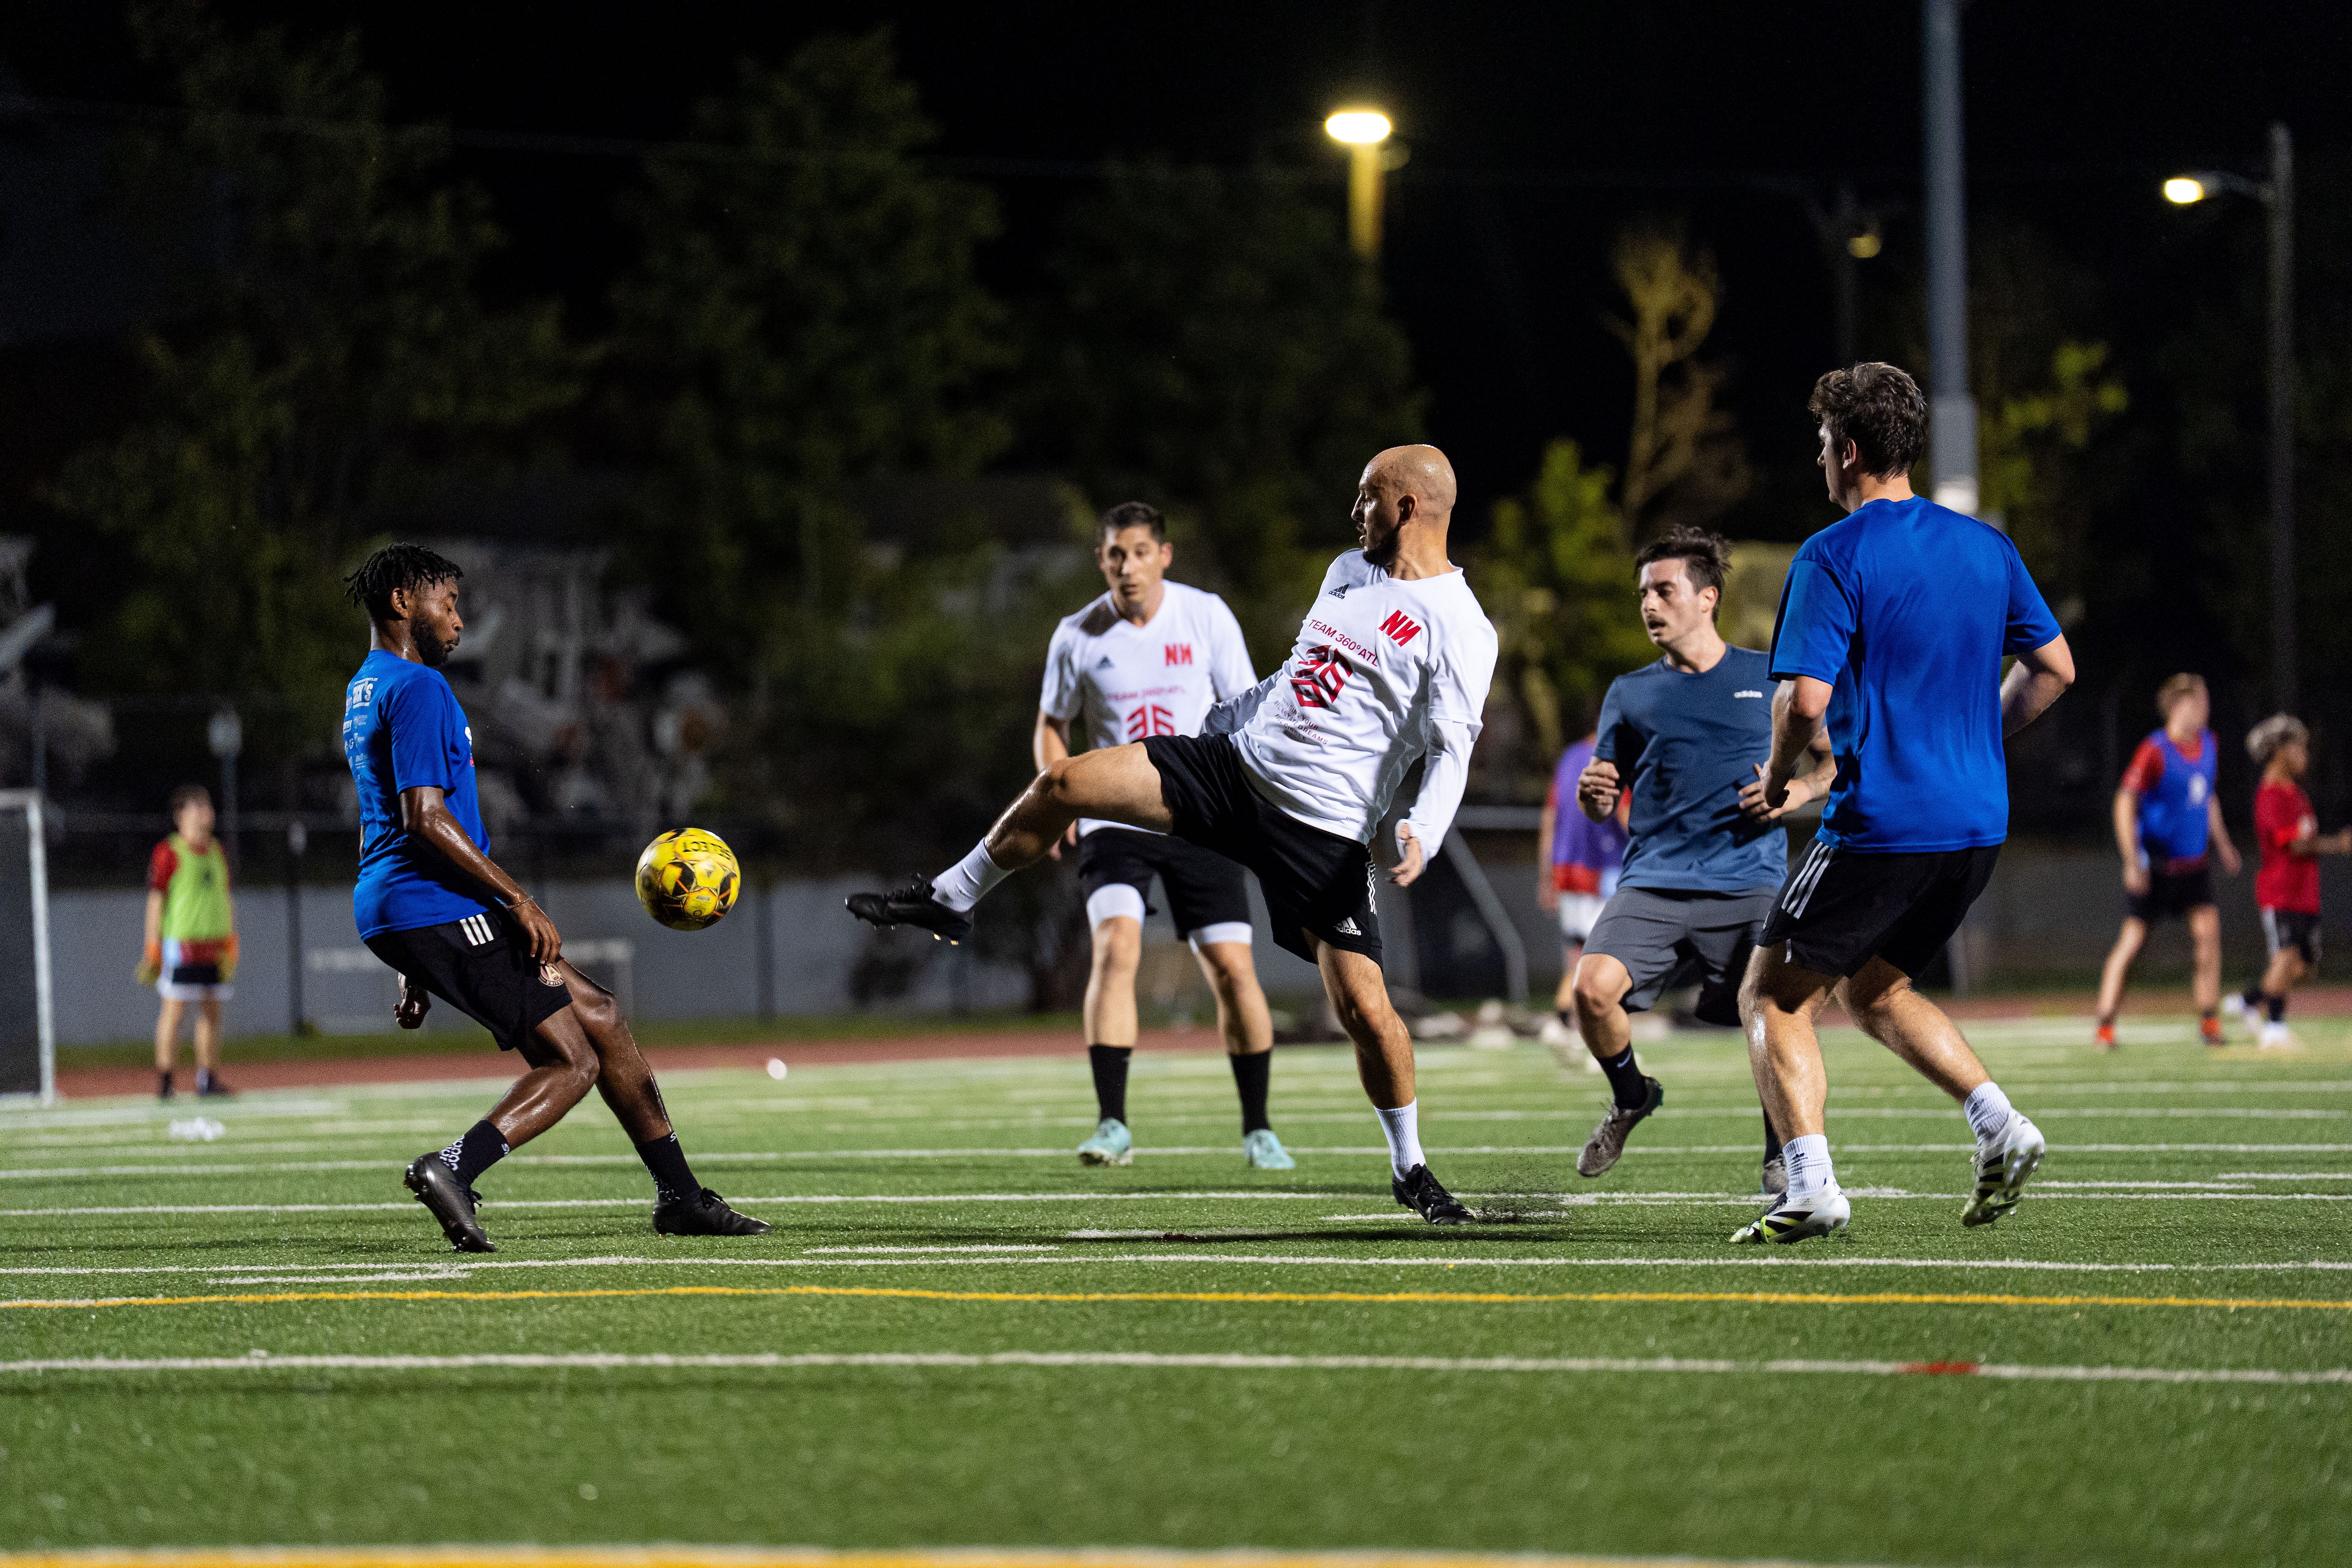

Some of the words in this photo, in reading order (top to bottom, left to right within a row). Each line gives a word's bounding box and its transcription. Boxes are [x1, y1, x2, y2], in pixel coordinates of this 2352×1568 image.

[1328, 590, 1345, 599] adidas
[1308, 619, 1337, 637] TEAM
[1302, 715, 1319, 730] YOUR
[1298, 724, 1328, 744] DREAMS
